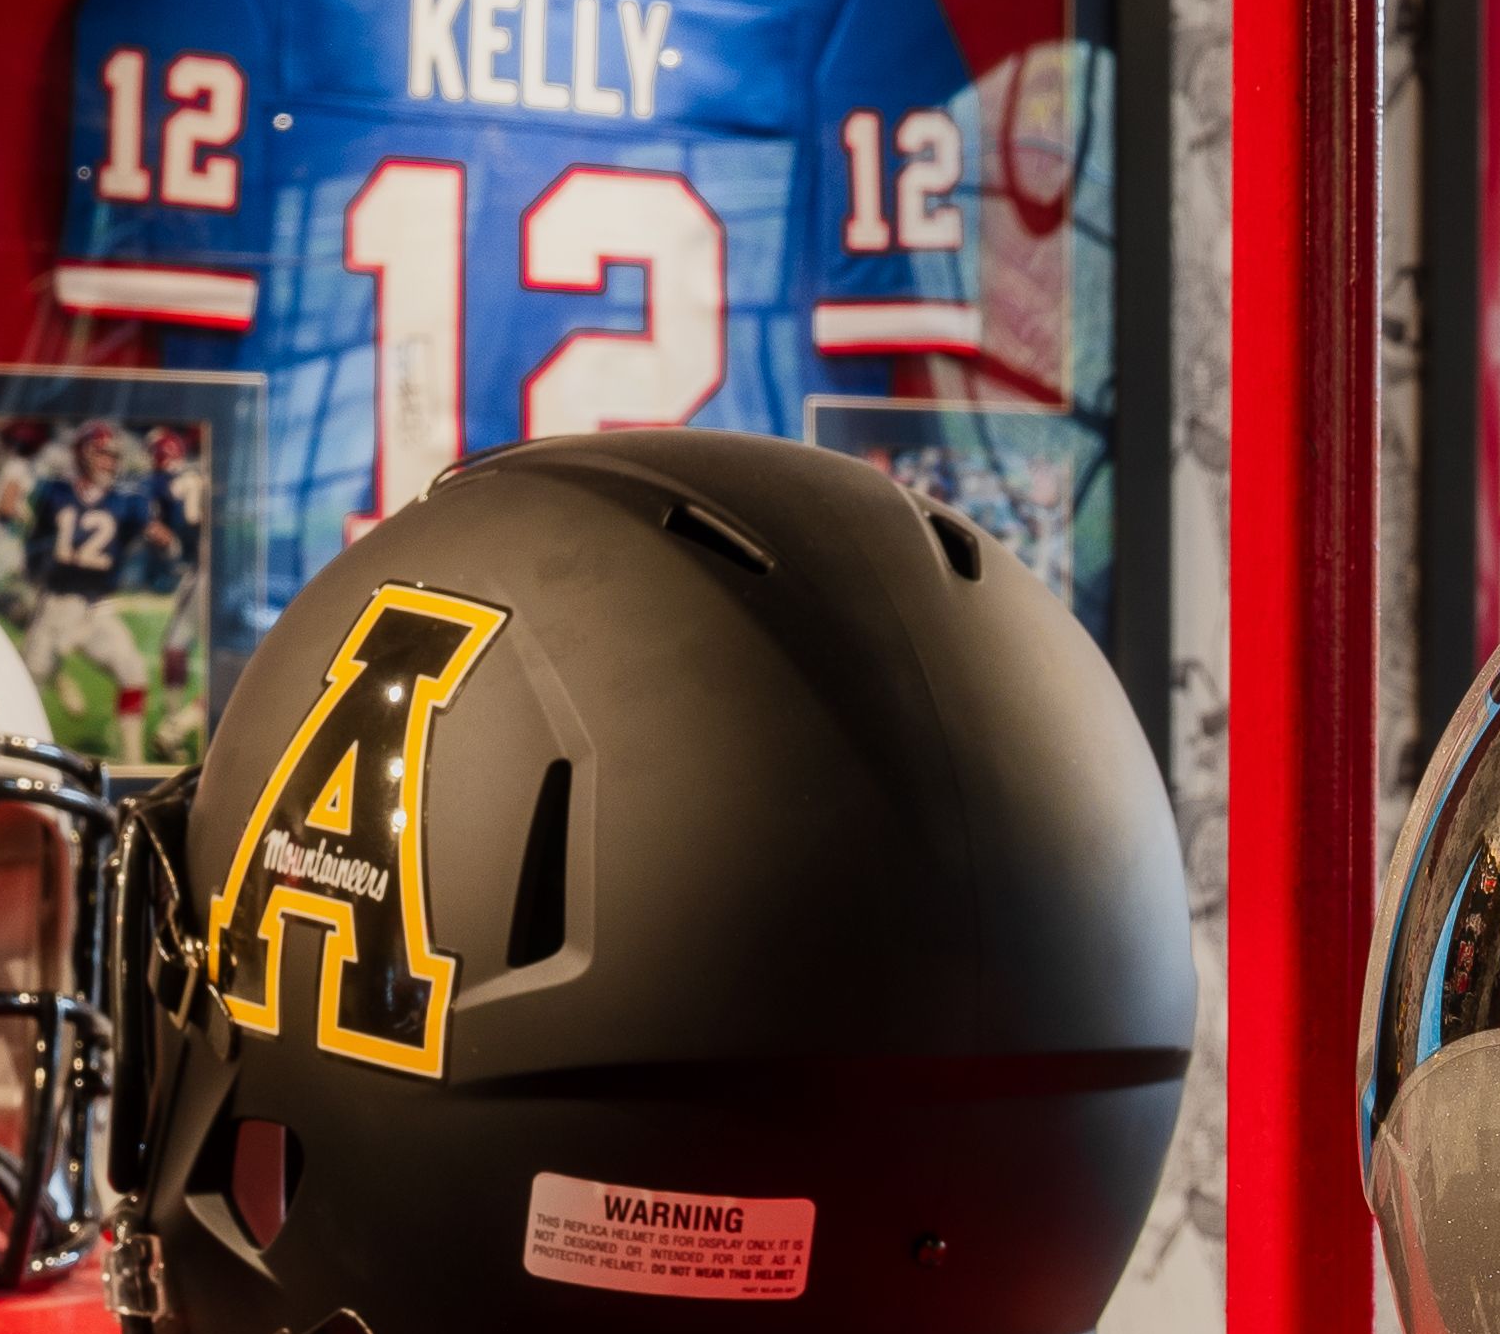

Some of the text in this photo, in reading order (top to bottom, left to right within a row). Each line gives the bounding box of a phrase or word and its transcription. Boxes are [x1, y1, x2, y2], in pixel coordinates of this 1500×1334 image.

[97, 45, 248, 214] 12
[841, 107, 965, 257] 12
[343, 155, 726, 552] 12
[54, 505, 118, 572] 12
[209, 583, 508, 1079] A
[263, 829, 389, 902] Mountaineers
[534, 1228, 802, 1266] NOT DESIGNED OR INTENDED FOR USE AS A
[536, 1212, 560, 1229] THIS
[563, 1219, 608, 1238] REPLICA
[611, 1229, 655, 1243] HELMET
[659, 1234, 670, 1245] IS
[673, 1235, 695, 1247] FOR
[698, 1236, 743, 1250] DISPLAY
[604, 1194, 744, 1234] WARNING
[532, 1243, 596, 1267] PROTECTIVE
[650, 1263, 667, 1275] DO
[669, 1265, 692, 1277] NOT
[695, 1267, 725, 1279] WEAR
[728, 1268, 752, 1280] THIS
